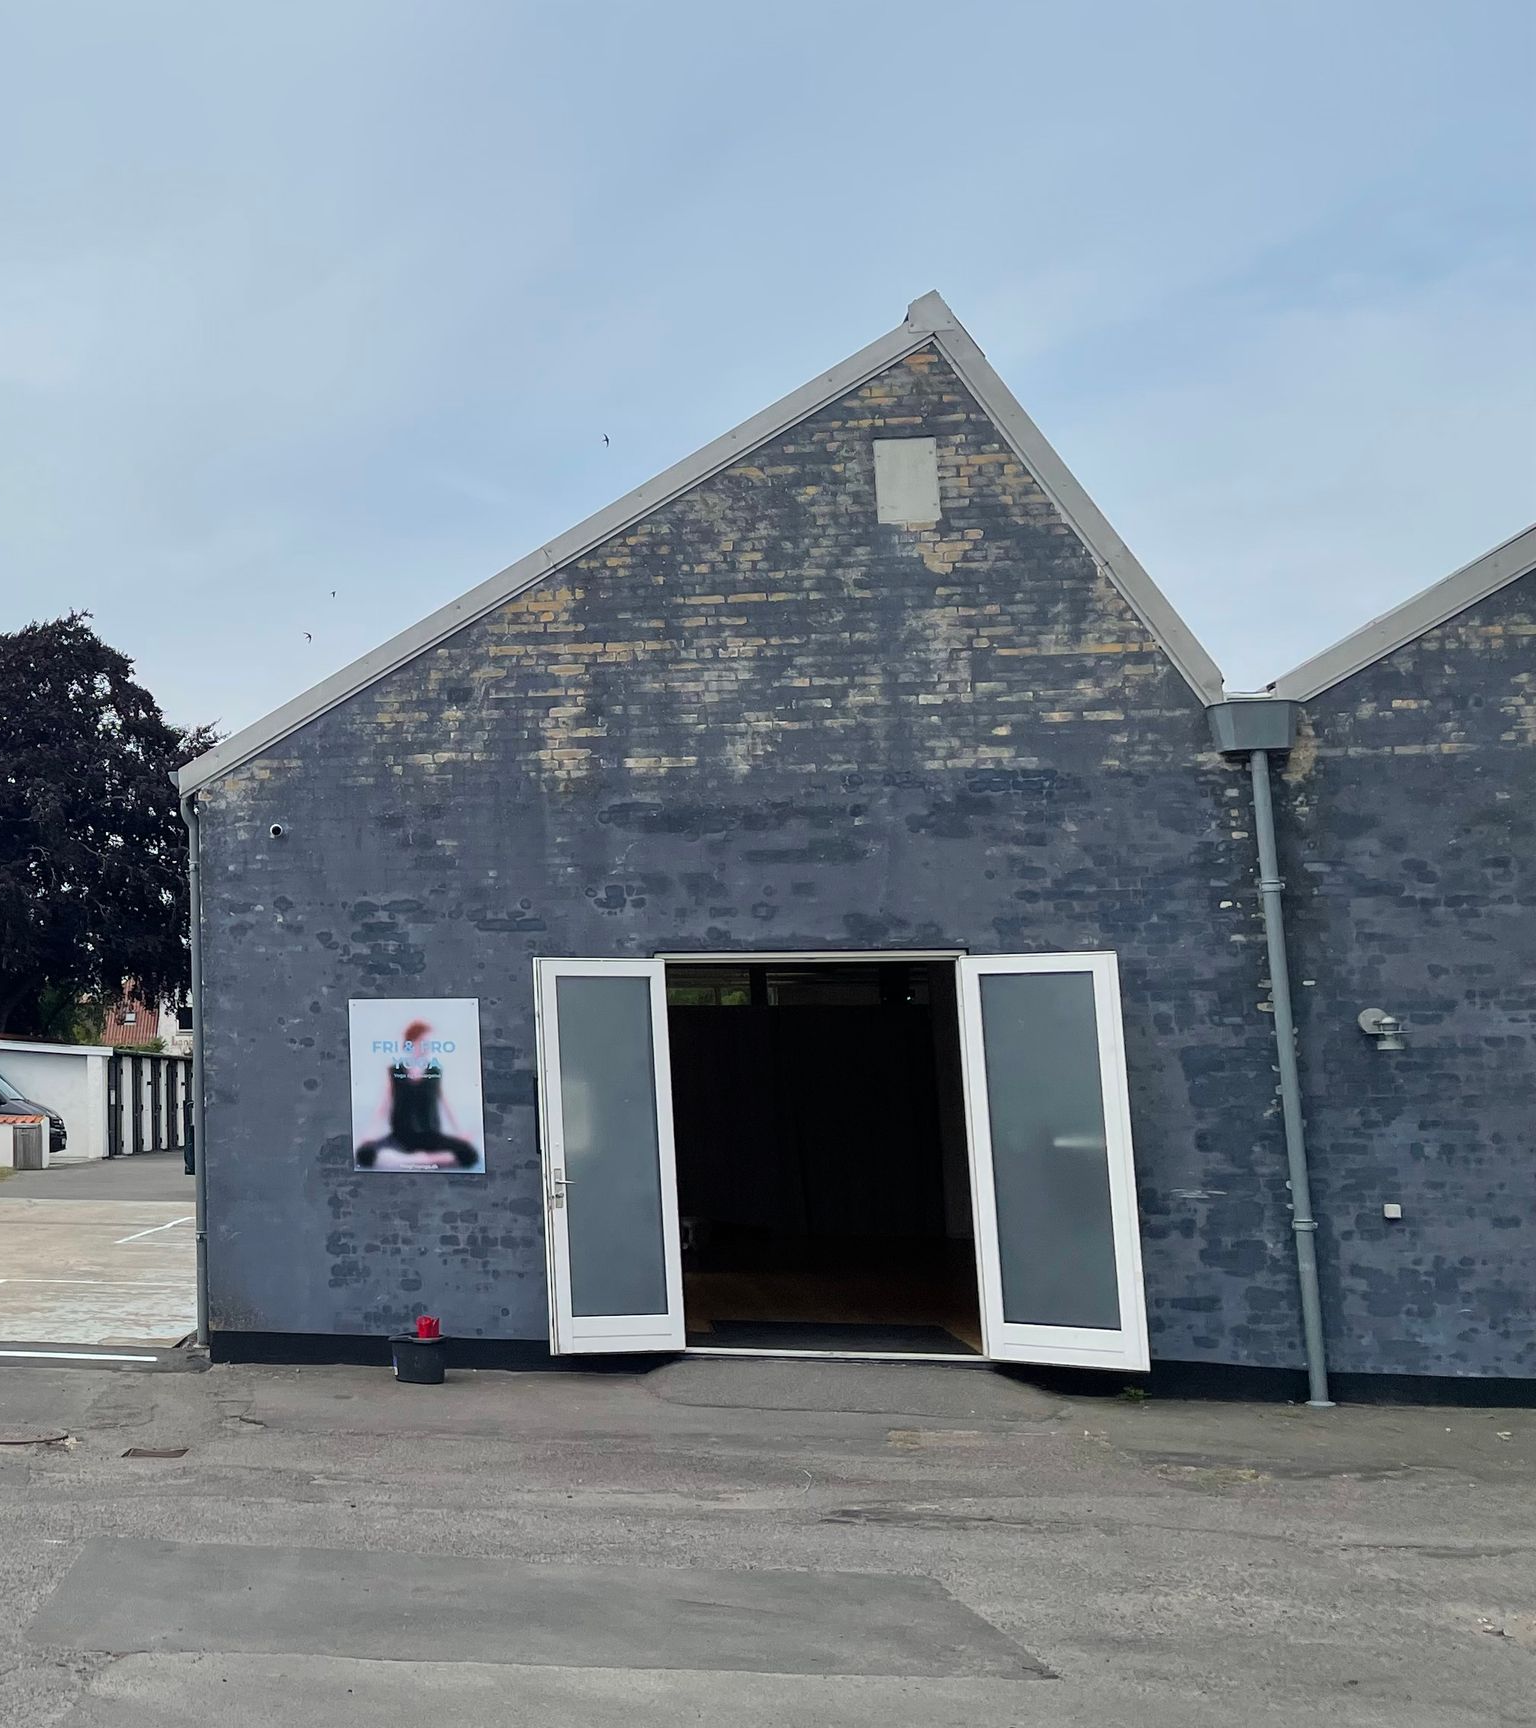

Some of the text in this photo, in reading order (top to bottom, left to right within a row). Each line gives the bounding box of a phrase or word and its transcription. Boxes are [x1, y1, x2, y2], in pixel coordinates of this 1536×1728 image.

[372, 1040, 456, 1053] FRI & FRO
